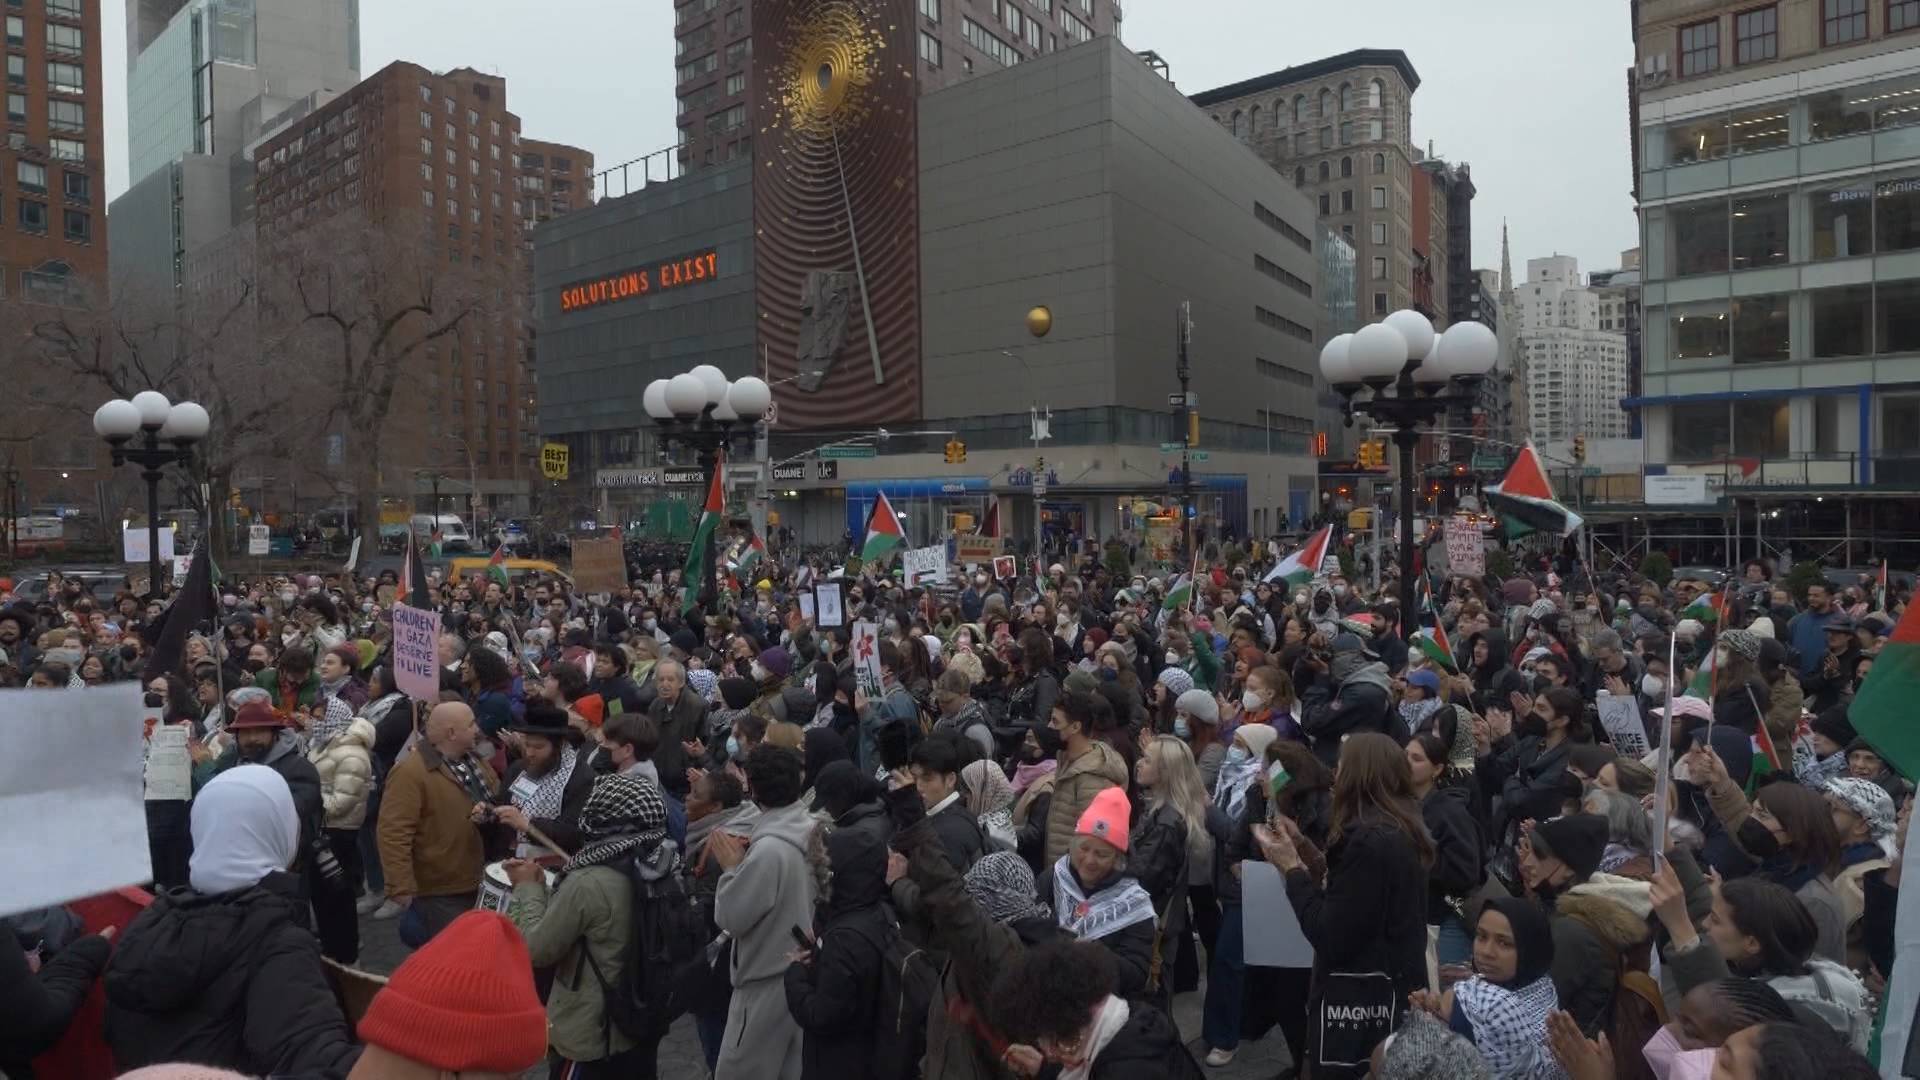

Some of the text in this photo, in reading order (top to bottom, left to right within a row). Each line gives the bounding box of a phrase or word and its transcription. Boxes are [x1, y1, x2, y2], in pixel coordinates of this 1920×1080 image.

[561, 252, 718, 310] SOLUTIONS EXIST
[544, 449, 567, 462] BEST
[546, 461, 565, 473] BUY
[394, 609, 434, 631] CHILDREN
[406, 629, 431, 649] GAZA
[396, 641, 432, 662] DESERVE
[407, 660, 432, 678] LIVE
